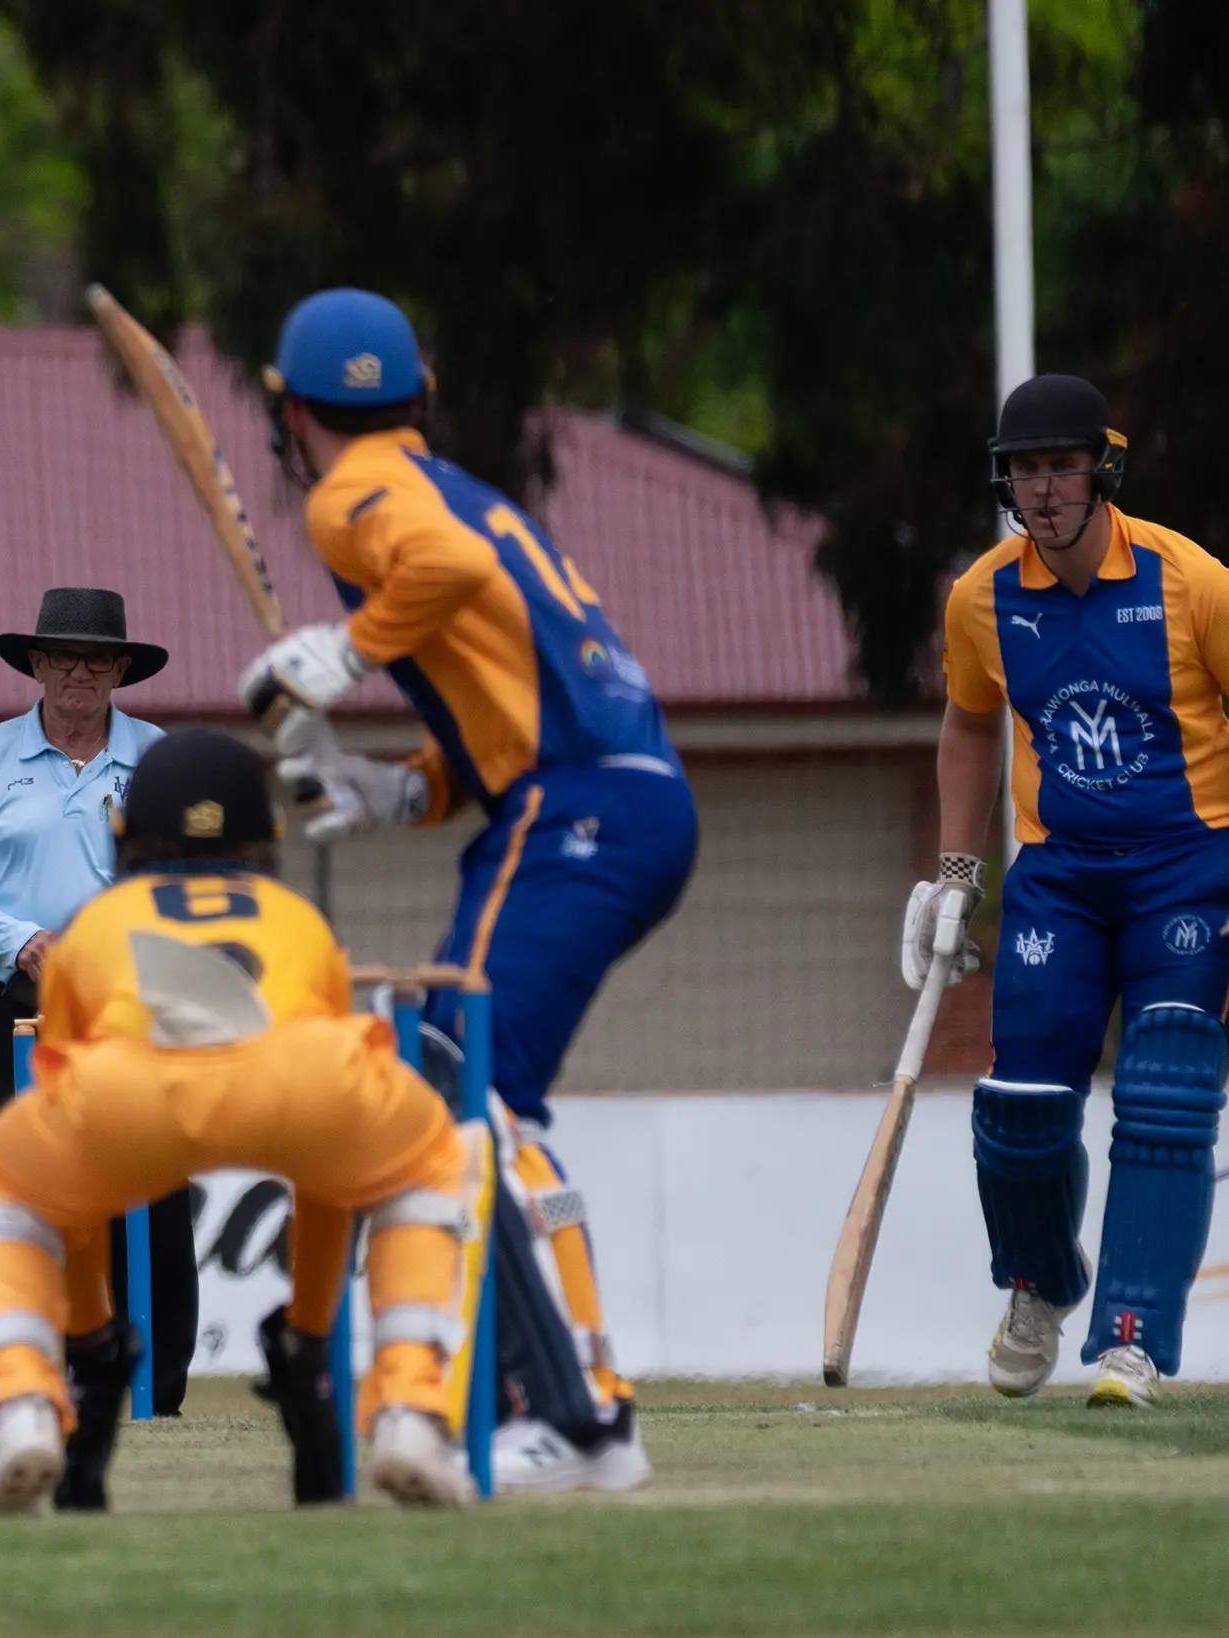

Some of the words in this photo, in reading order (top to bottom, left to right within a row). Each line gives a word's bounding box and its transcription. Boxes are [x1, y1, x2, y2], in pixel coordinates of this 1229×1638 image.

[1117, 607, 1134, 624] EST
[1057, 762, 1115, 791] CRICKET
[1116, 751, 1150, 785] CLUB
